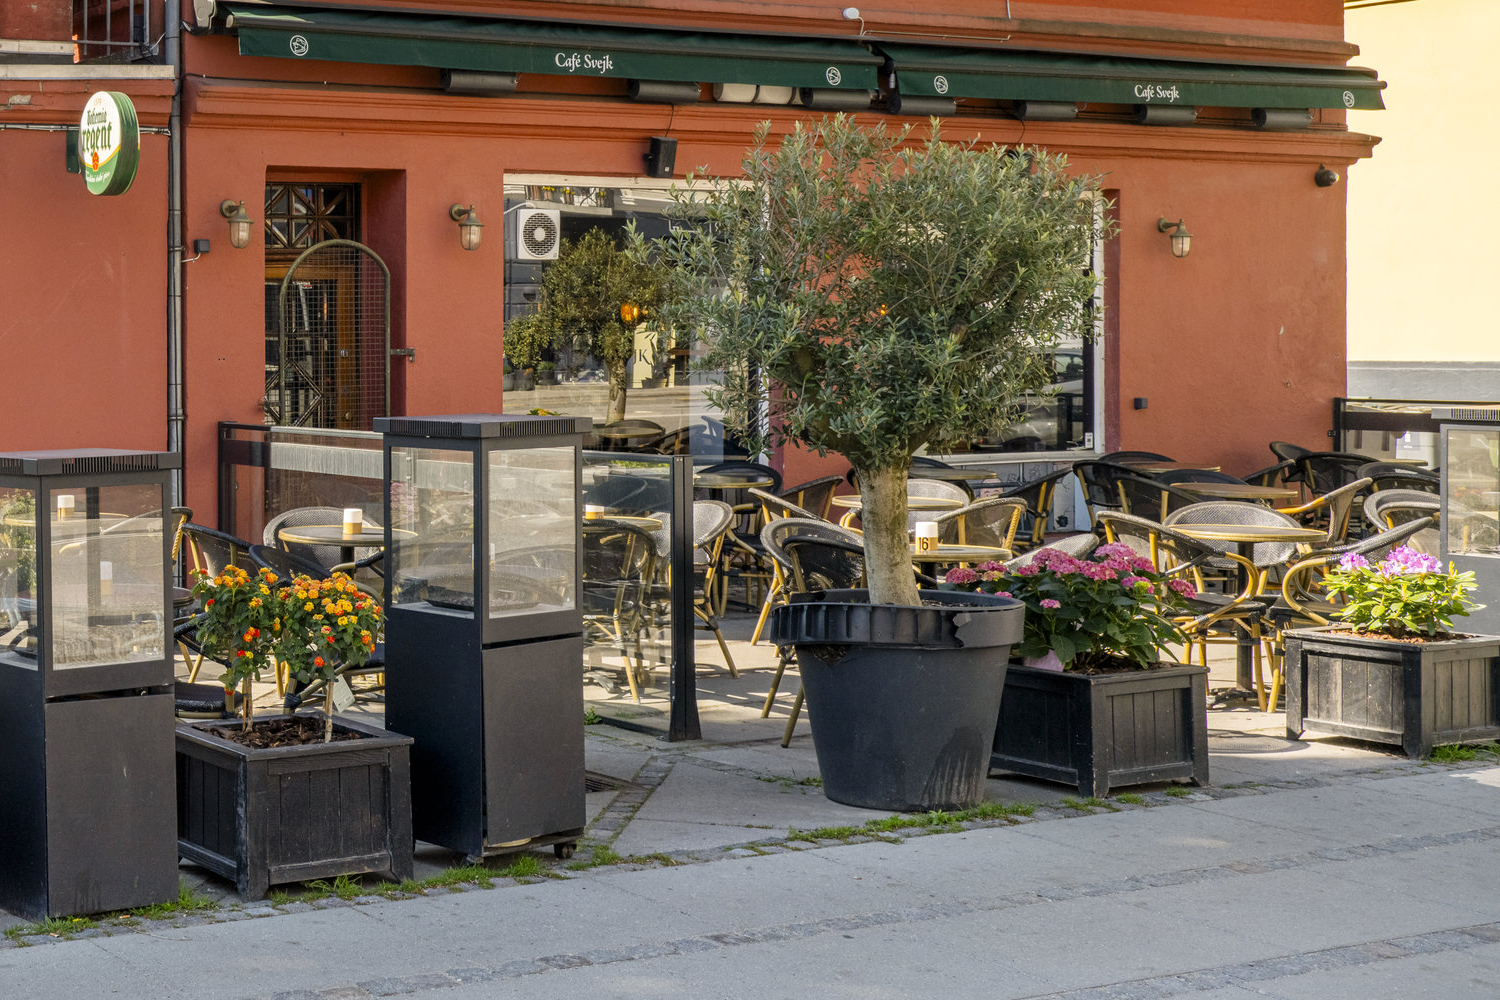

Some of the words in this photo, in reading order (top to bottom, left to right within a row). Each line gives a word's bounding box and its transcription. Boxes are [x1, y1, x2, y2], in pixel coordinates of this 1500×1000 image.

[555, 52, 581, 72] Café
[584, 53, 614, 74] Svejk
[1134, 84, 1155, 102] Café
[1156, 85, 1180, 103] Svejk
[82, 121, 112, 157] regent
[918, 536, 929, 551] 16
